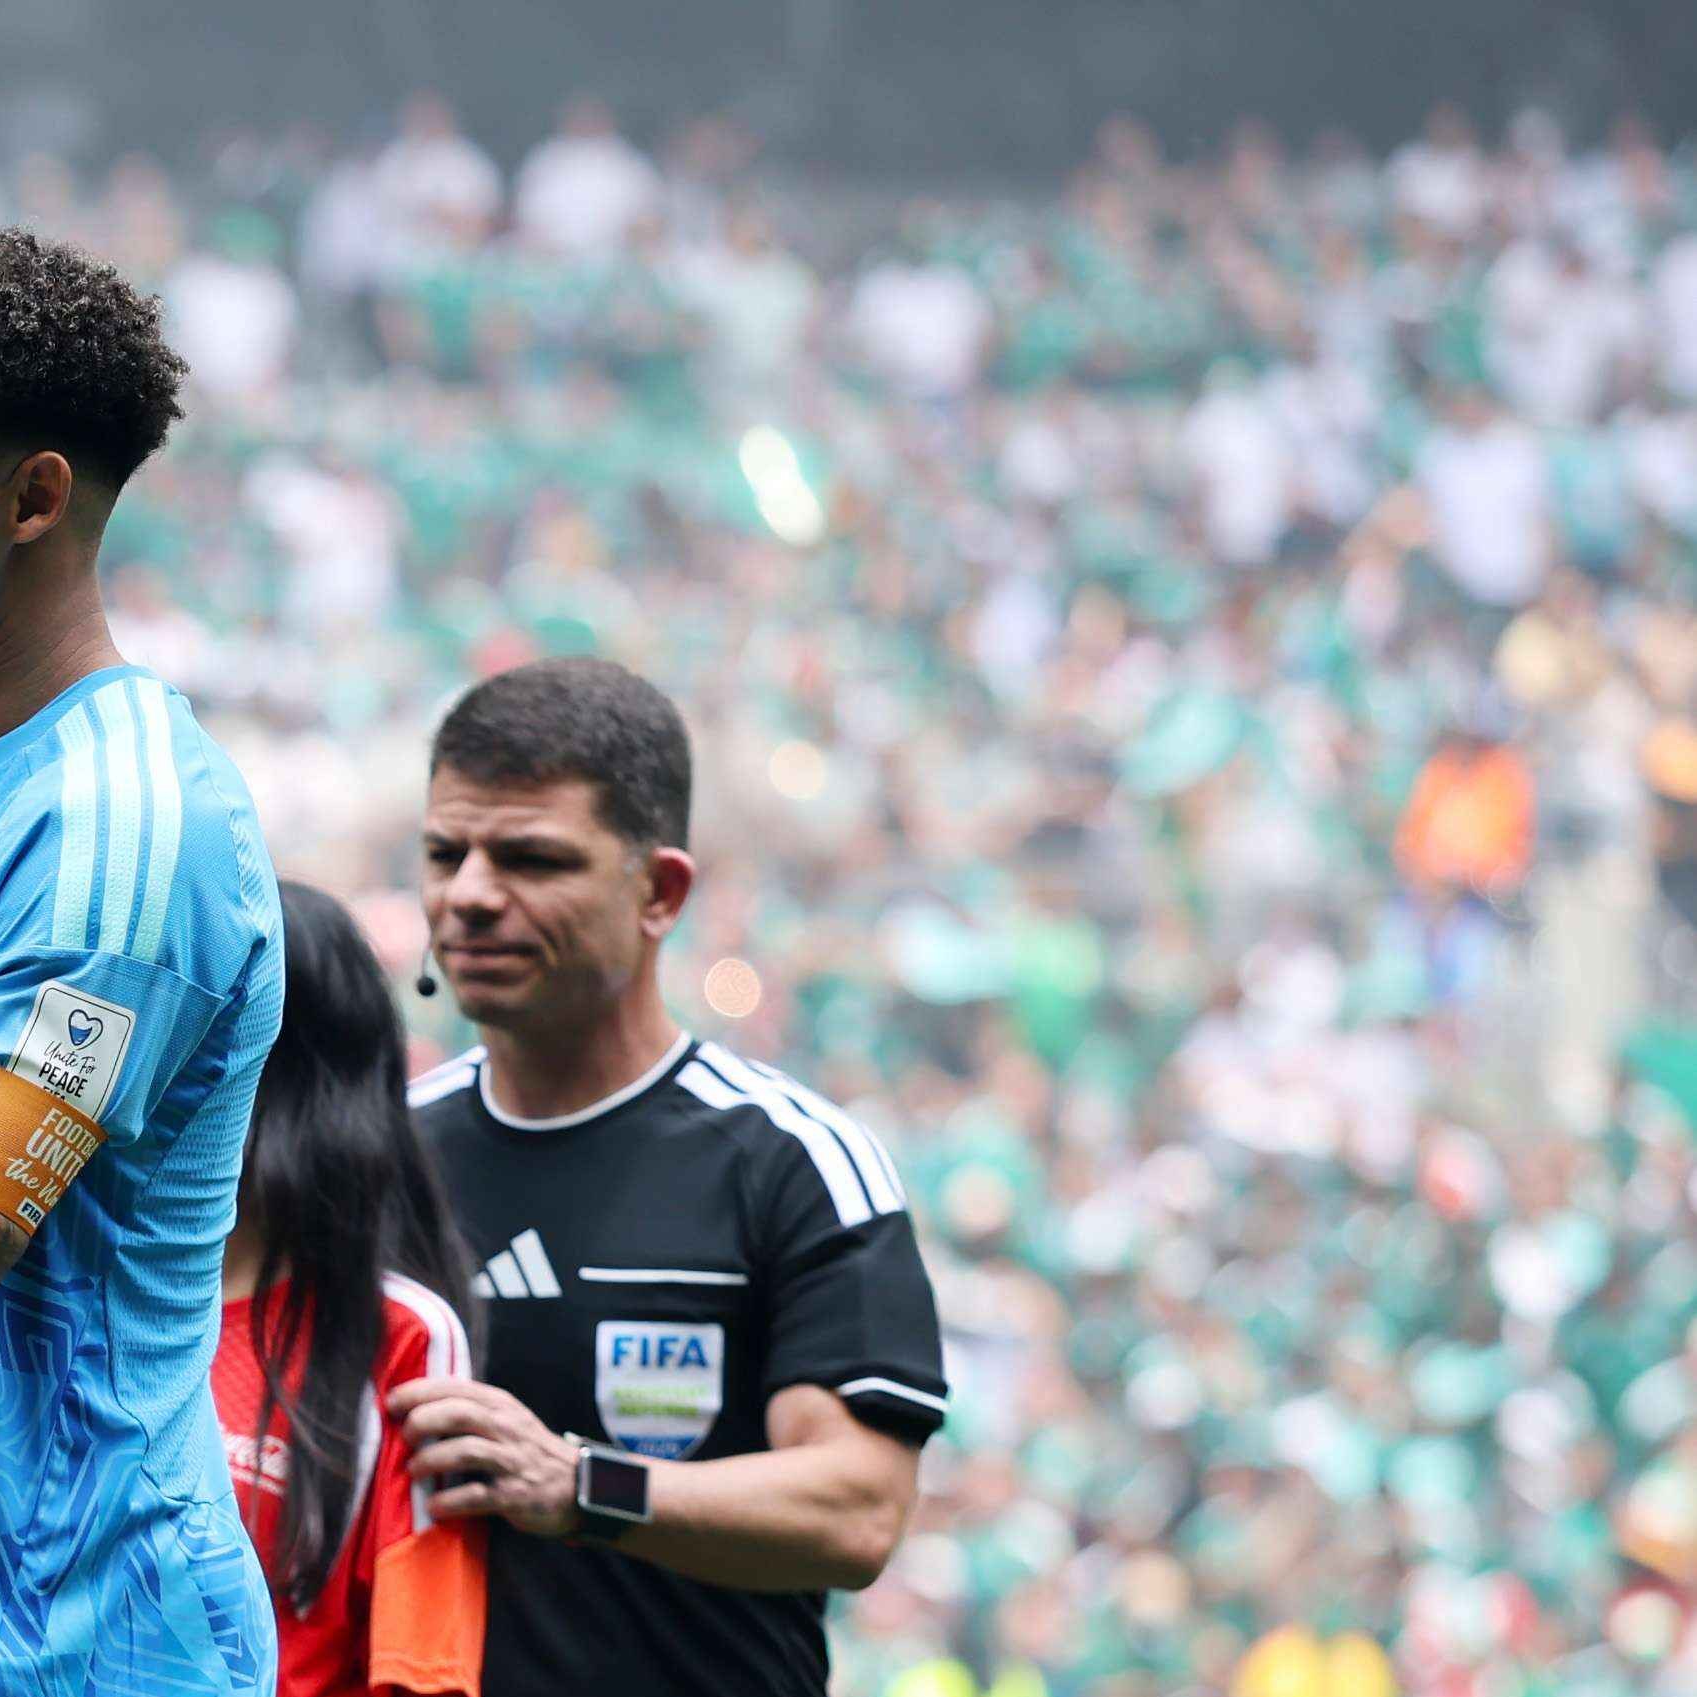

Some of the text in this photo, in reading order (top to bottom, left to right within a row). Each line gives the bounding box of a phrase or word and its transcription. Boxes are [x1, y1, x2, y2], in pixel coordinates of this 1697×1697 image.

[44, 1040, 97, 1075] Unite For
[38, 1061, 88, 1098] PEACE
[41, 1107, 100, 1158] FOOTB
[5, 1156, 39, 1190] the
[26, 1127, 86, 1187] UNIT
[612, 1334, 709, 1369] FIFA
